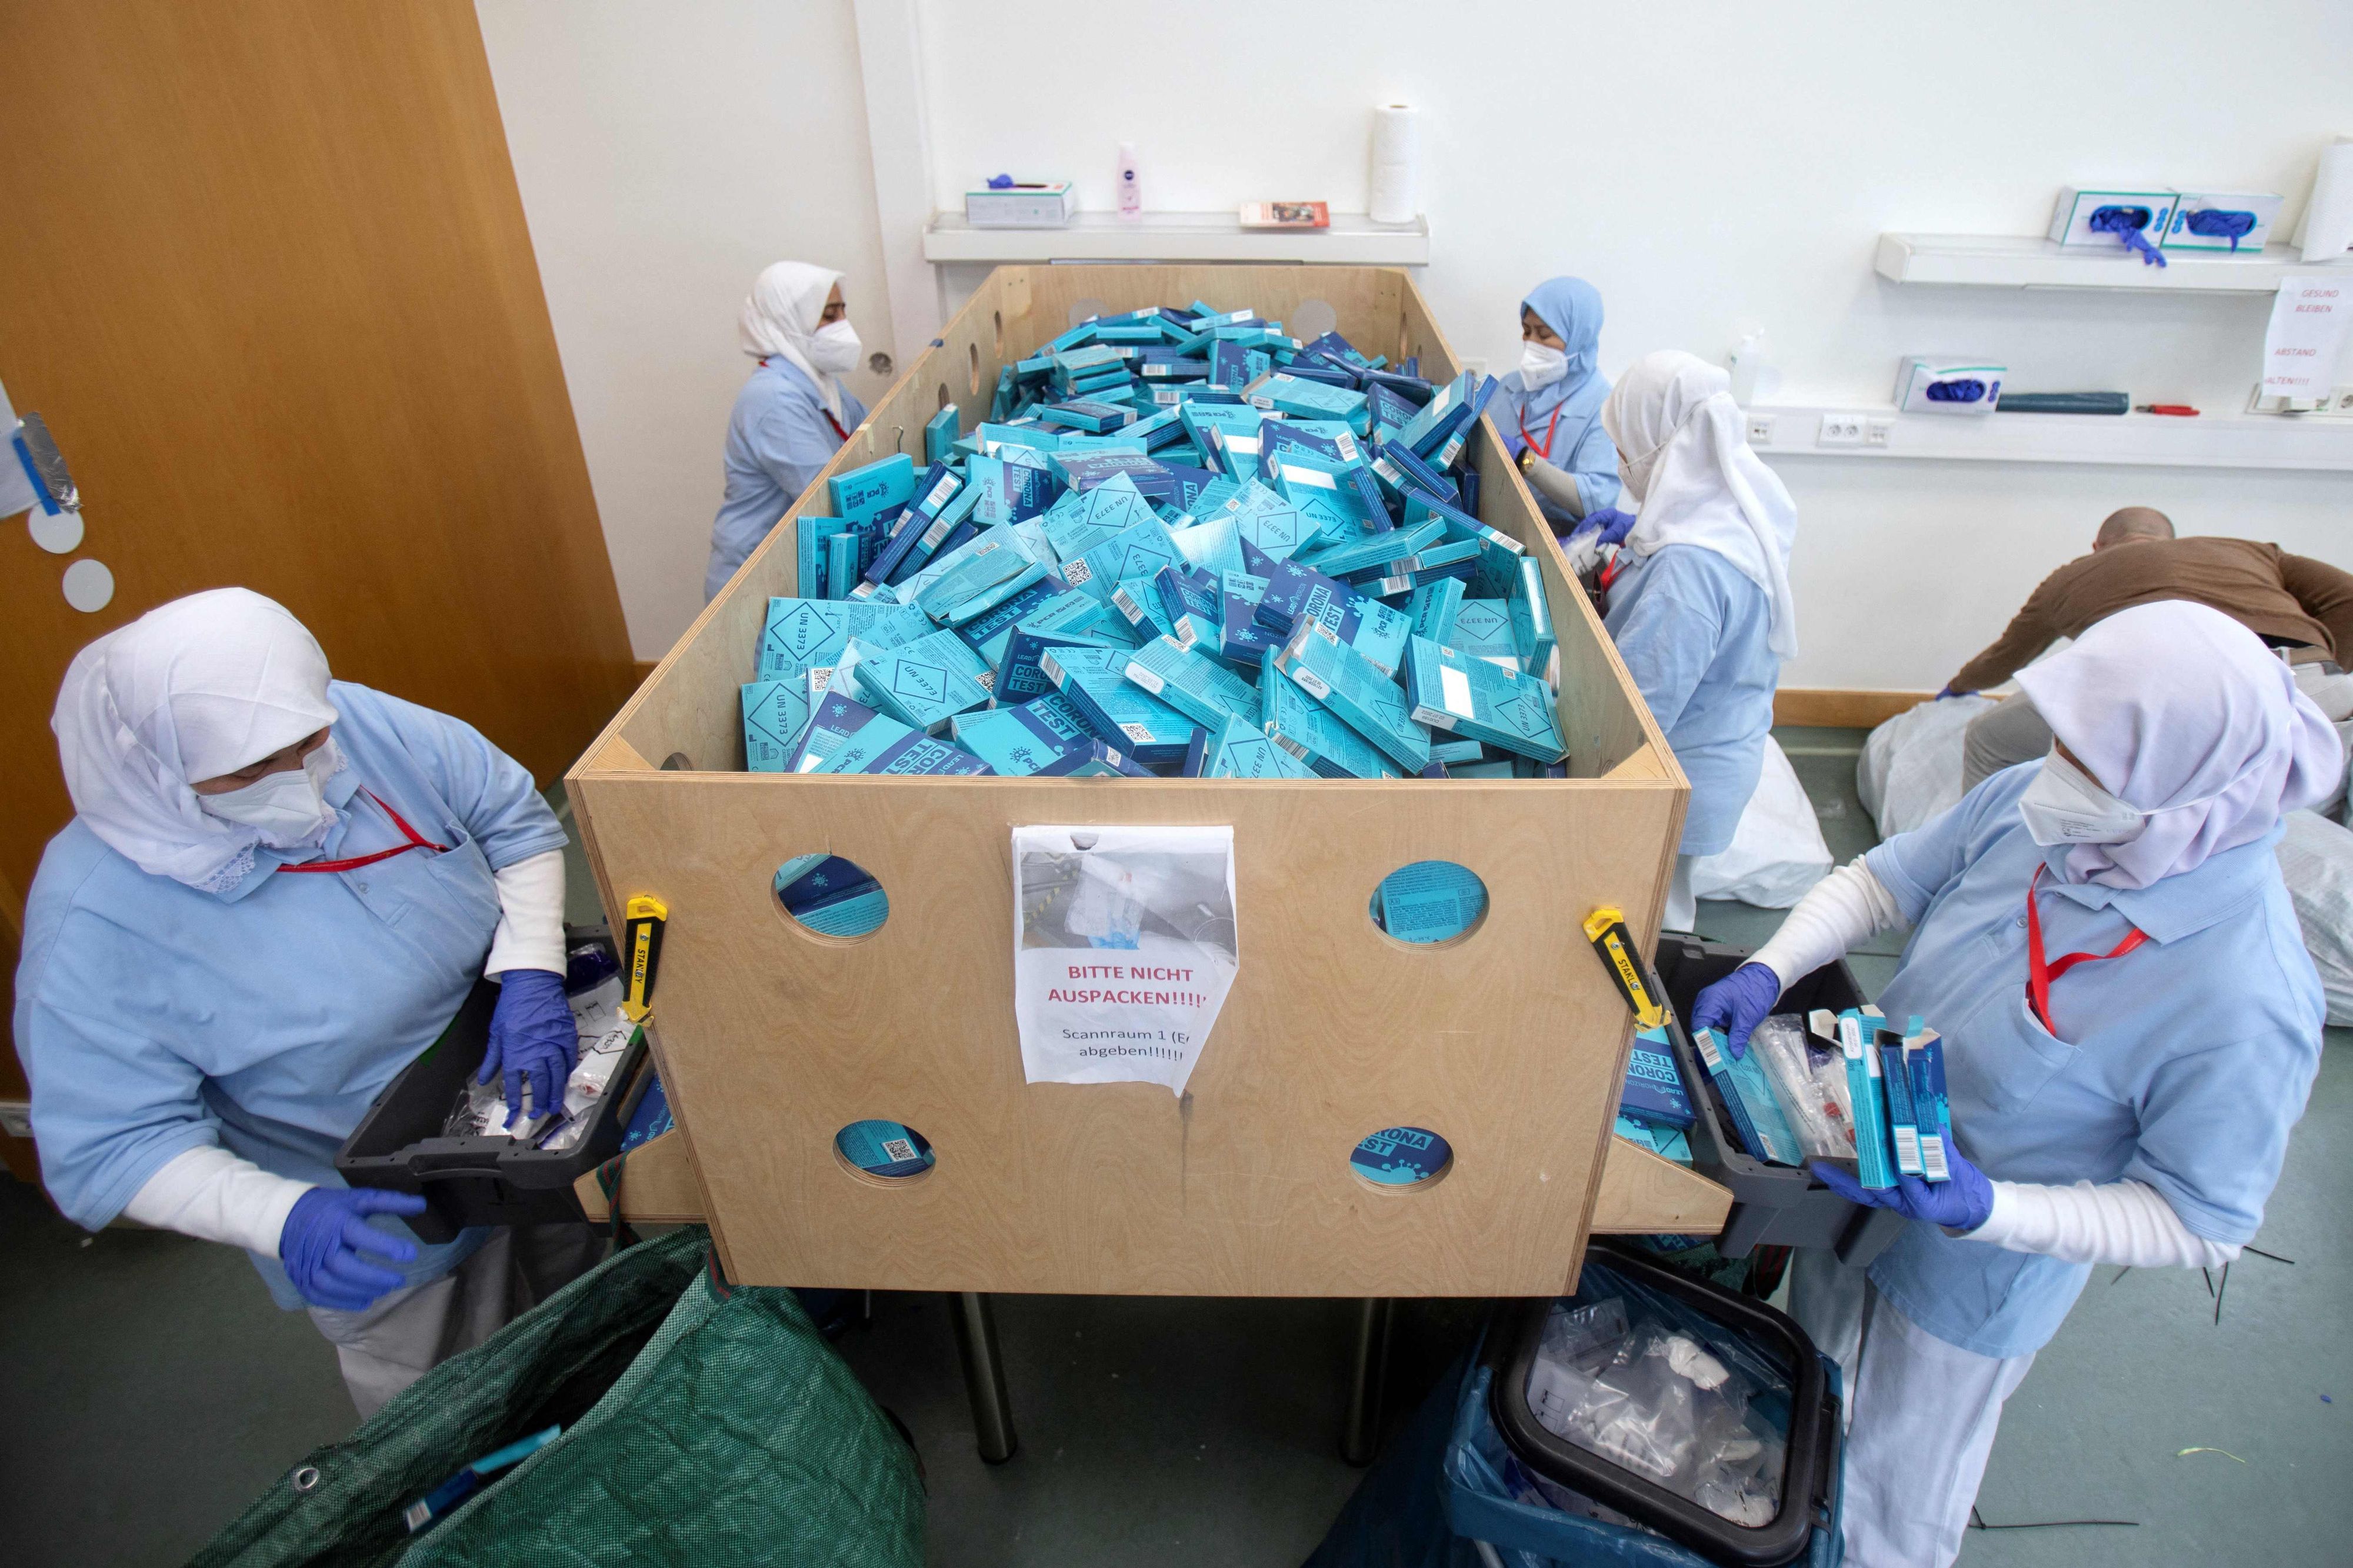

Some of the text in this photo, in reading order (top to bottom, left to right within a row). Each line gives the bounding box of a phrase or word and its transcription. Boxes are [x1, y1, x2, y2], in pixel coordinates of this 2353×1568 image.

[2301, 289, 2339, 298] GESUND
[2274, 348, 2317, 356] ABSTAND
[2265, 376, 2309, 385] ALTEN!!!!
[1383, 402, 1413, 419] CORO
[867, 488, 879, 499] PCR
[1024, 469, 1032, 506] CORONA
[1187, 483, 1197, 510] ONA
[1095, 496, 1128, 520] UN 3373
[1319, 513, 1337, 522] 3373
[1264, 520, 1291, 542] UN 3373
[1133, 553, 1149, 576] 3373
[1184, 590, 1218, 613] CORONA
[1188, 599, 1211, 616] TEST
[1287, 582, 1307, 615] LEAD HORIZON
[1308, 587, 1329, 617] ORONA
[968, 590, 1035, 631] CORONA
[1036, 612, 1056, 625] PCR
[1324, 606, 1342, 632] TEST
[1420, 610, 1428, 628] PCR
[796, 612, 809, 650] UN 3373
[974, 609, 1019, 639] TEST
[1380, 618, 1388, 632] PCR
[905, 666, 938, 696] UN 3373
[1015, 666, 1049, 680] CORO
[1012, 679, 1045, 693] TEST
[776, 695, 788, 735] UN 3373
[1032, 703, 1075, 736] TEST
[1049, 695, 1108, 744] CORON
[1247, 706, 1258, 718] 3373
[1421, 710, 1444, 720] 02.07.2022
[1518, 704, 1530, 731] UN 3373
[831, 724, 850, 738] LEAD
[1397, 723, 1404, 733] UN
[908, 748, 946, 775] COR
[942, 754, 964, 770] LEAD
[1250, 746, 1266, 778] UN 337
[635, 949, 646, 984] STANY
[1068, 966, 1194, 982] BITTE NICHT
[1619, 959, 1641, 990] STANL
[1048, 989, 1207, 1008] AUSPACKEN!!!!
[1063, 1029, 1152, 1040] Scannraum
[1158, 1030, 1166, 1040] 1
[1634, 1051, 1671, 1067] TEST
[1628, 1063, 1675, 1082] CORON
[1664, 1087, 1684, 1096] LEAD
[646, 1104, 669, 1142] AD HORIZ
[1364, 1139, 1392, 1153] ST
[1379, 1129, 1427, 1147] RONA
